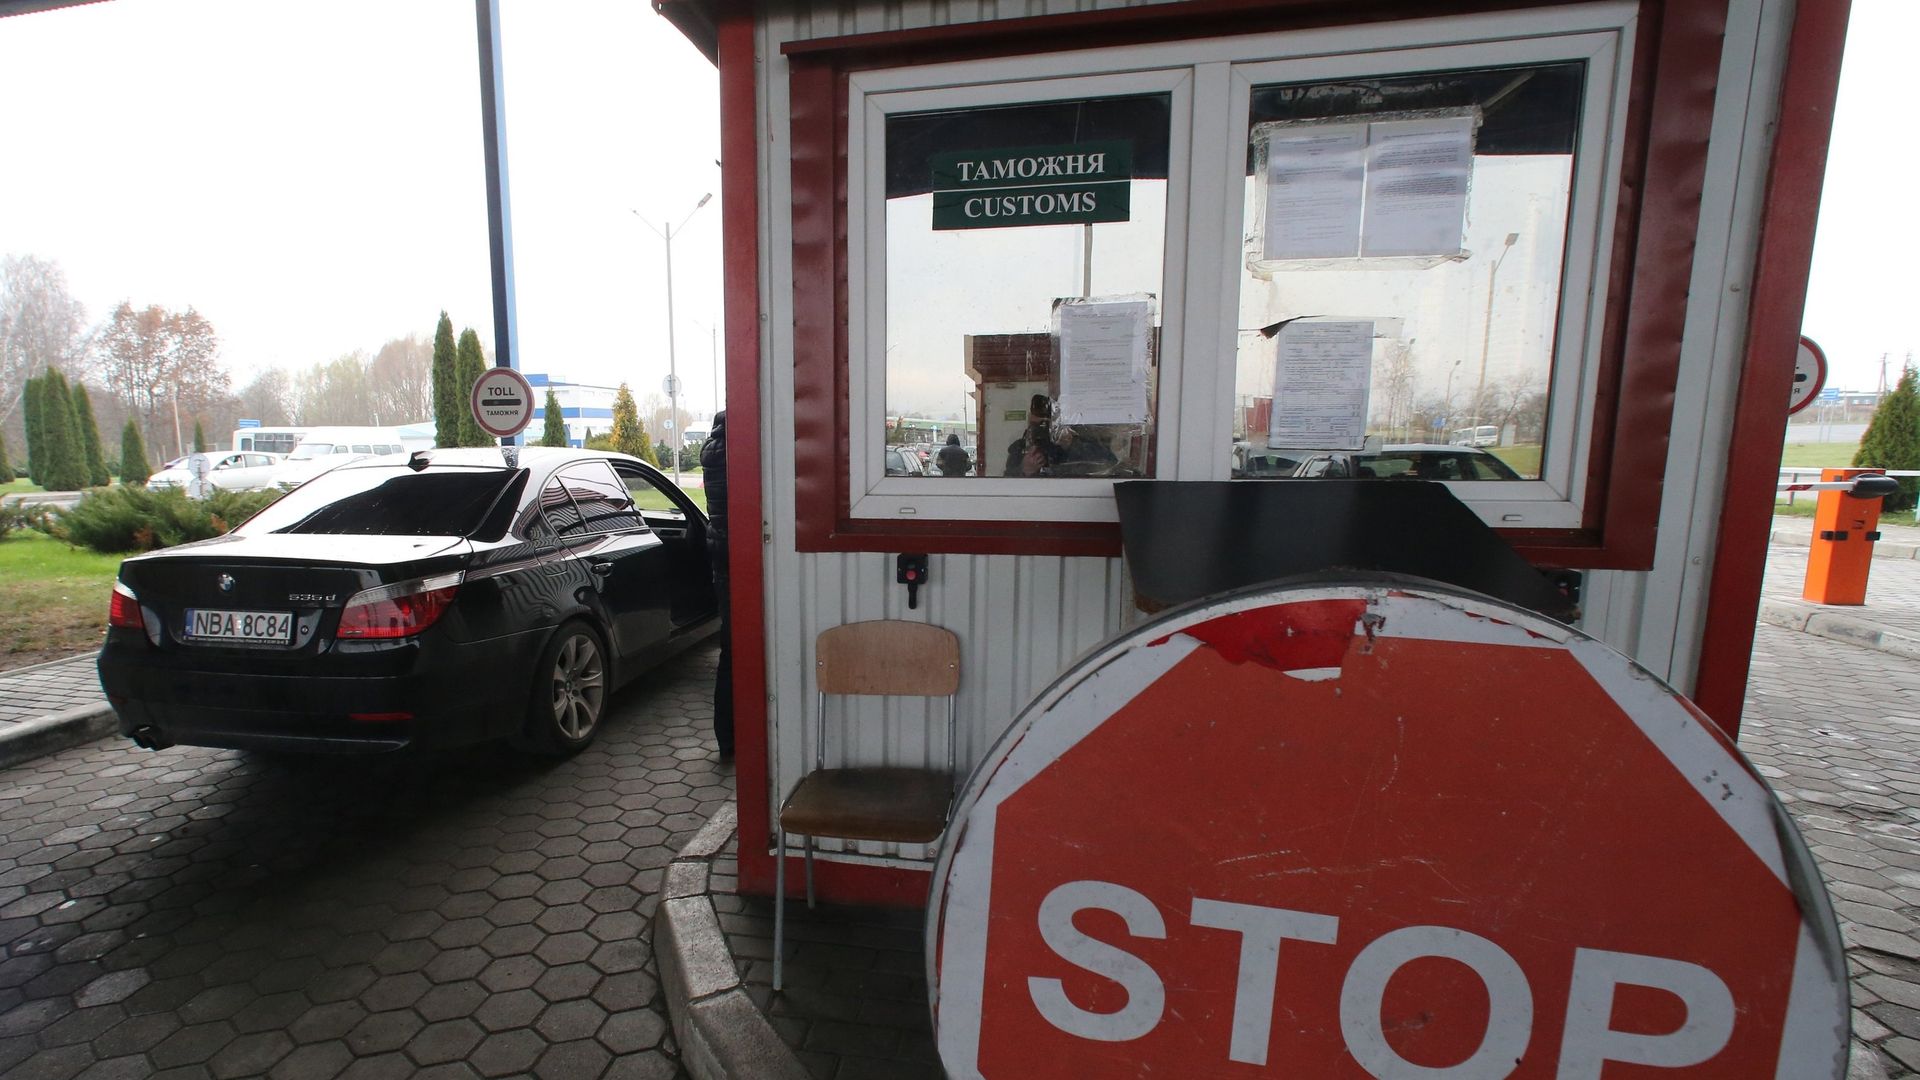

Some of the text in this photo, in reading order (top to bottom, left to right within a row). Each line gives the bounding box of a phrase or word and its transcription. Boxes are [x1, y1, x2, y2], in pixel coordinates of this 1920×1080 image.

[957, 153, 1106, 182] ТАМОЖНЯ
[964, 192, 1097, 218] CUSTOMS
[487, 386, 515, 396] TOLL
[195, 612, 290, 639] NBA 8C84
[1027, 880, 1737, 1080] STOP
